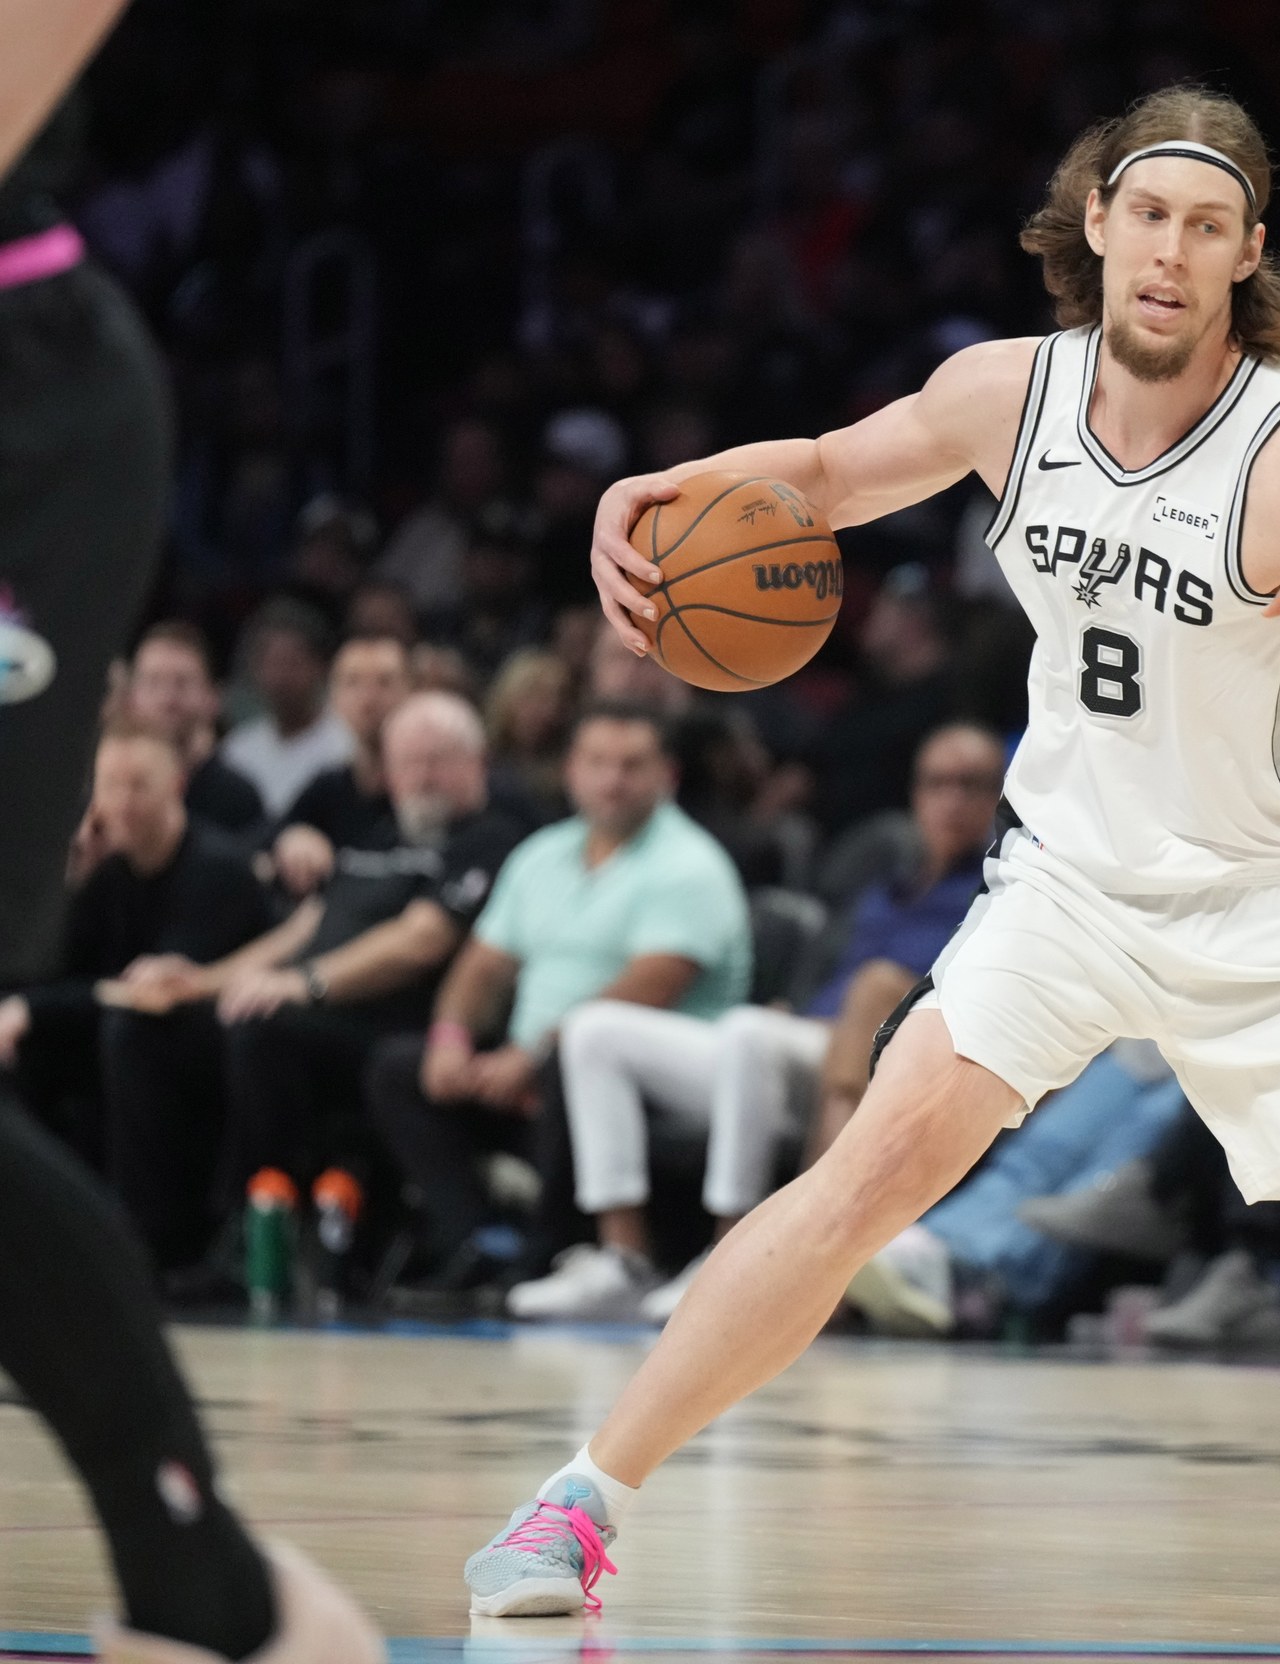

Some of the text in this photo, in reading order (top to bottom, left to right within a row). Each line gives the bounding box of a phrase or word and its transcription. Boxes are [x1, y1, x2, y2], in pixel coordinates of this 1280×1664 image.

[1162, 505, 1209, 530] LEDGER
[1025, 524, 1214, 627] SPURS
[1077, 622, 1144, 719] 8
